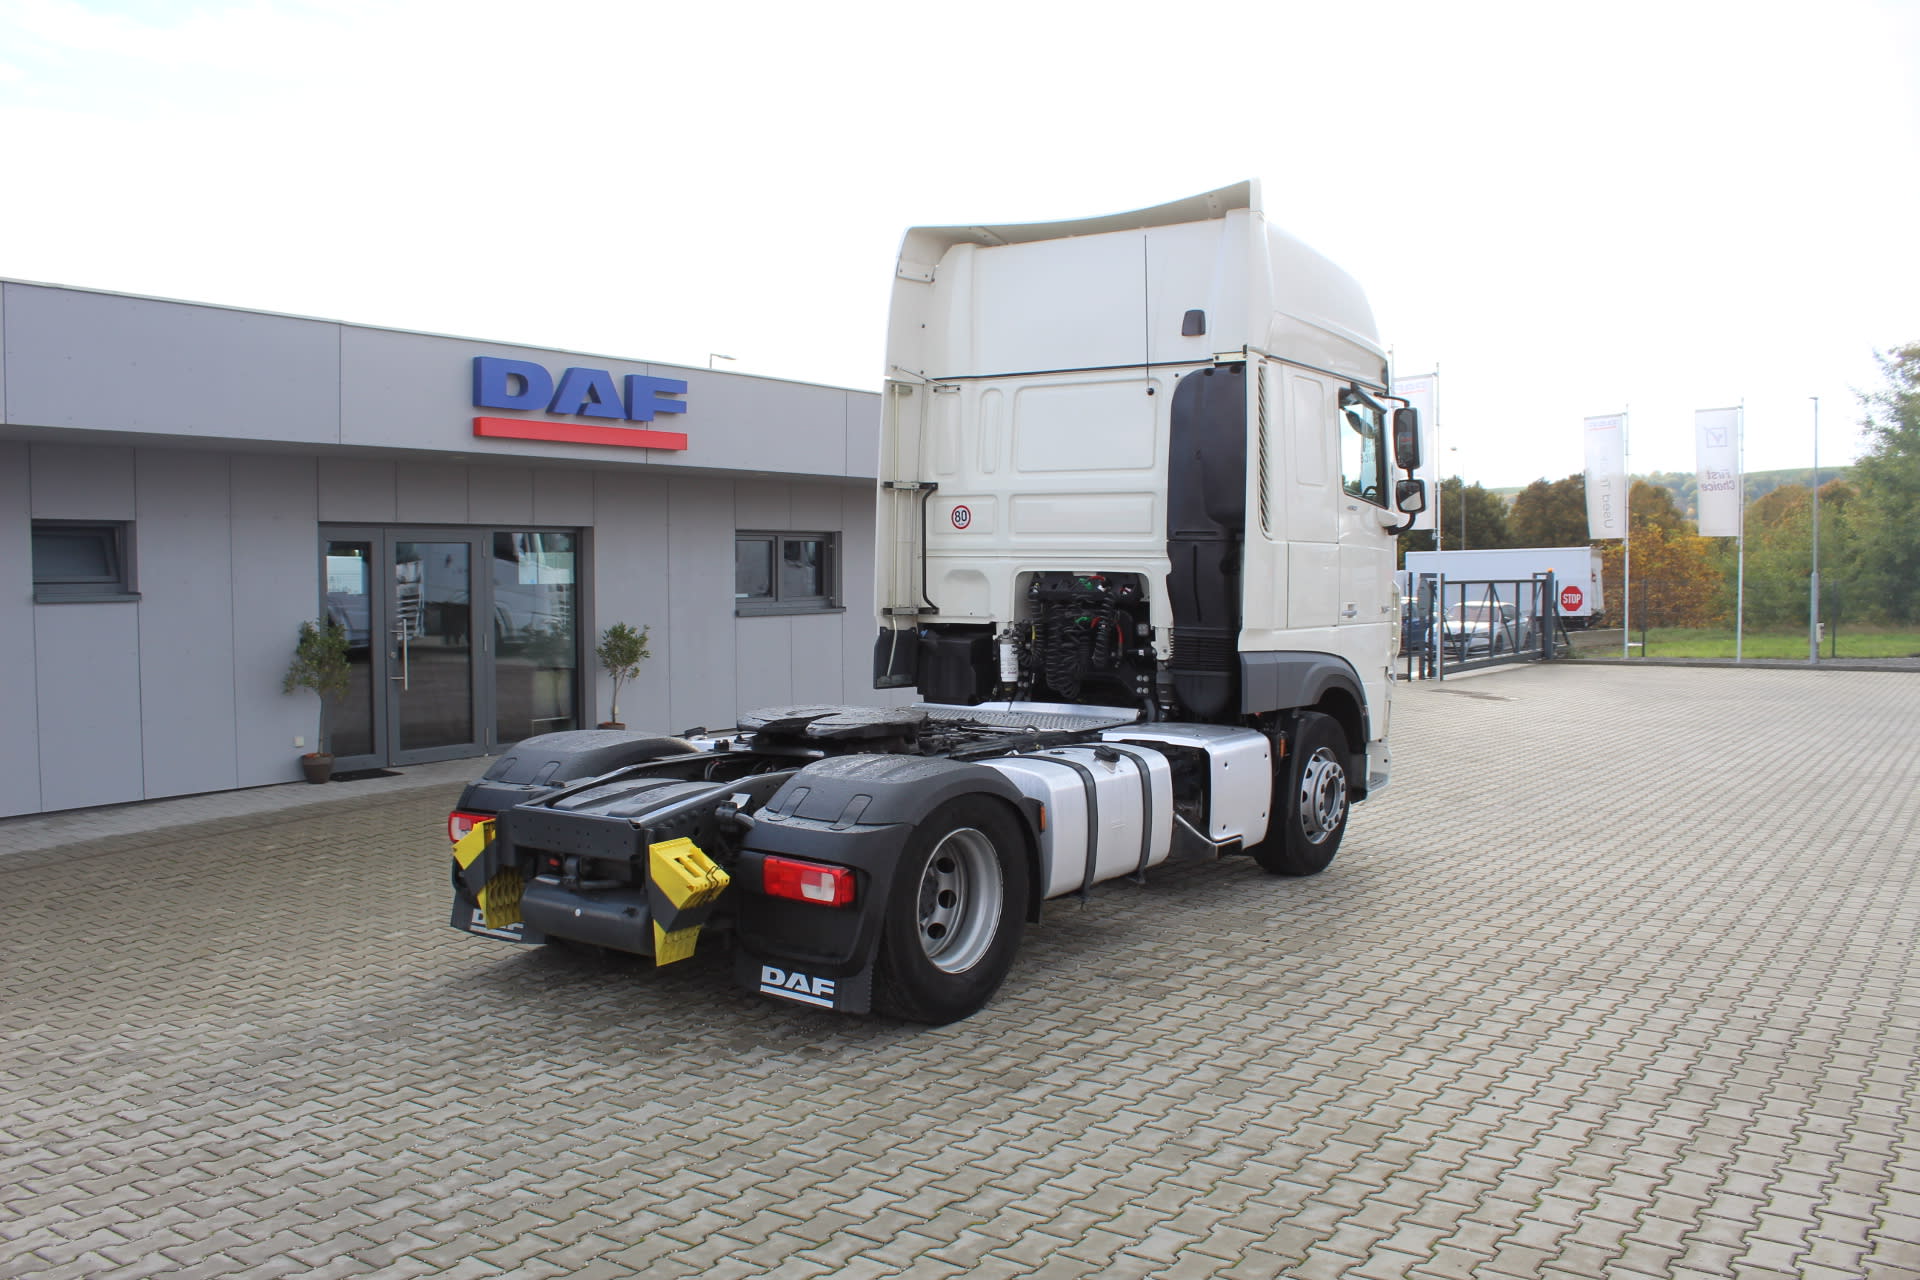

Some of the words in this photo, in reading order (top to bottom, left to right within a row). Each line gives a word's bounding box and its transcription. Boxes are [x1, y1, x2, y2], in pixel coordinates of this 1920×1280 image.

[473, 356, 688, 422] DAF
[955, 510, 967, 523] 80
[1563, 593, 1581, 604] STOP
[761, 965, 835, 996] DAF
